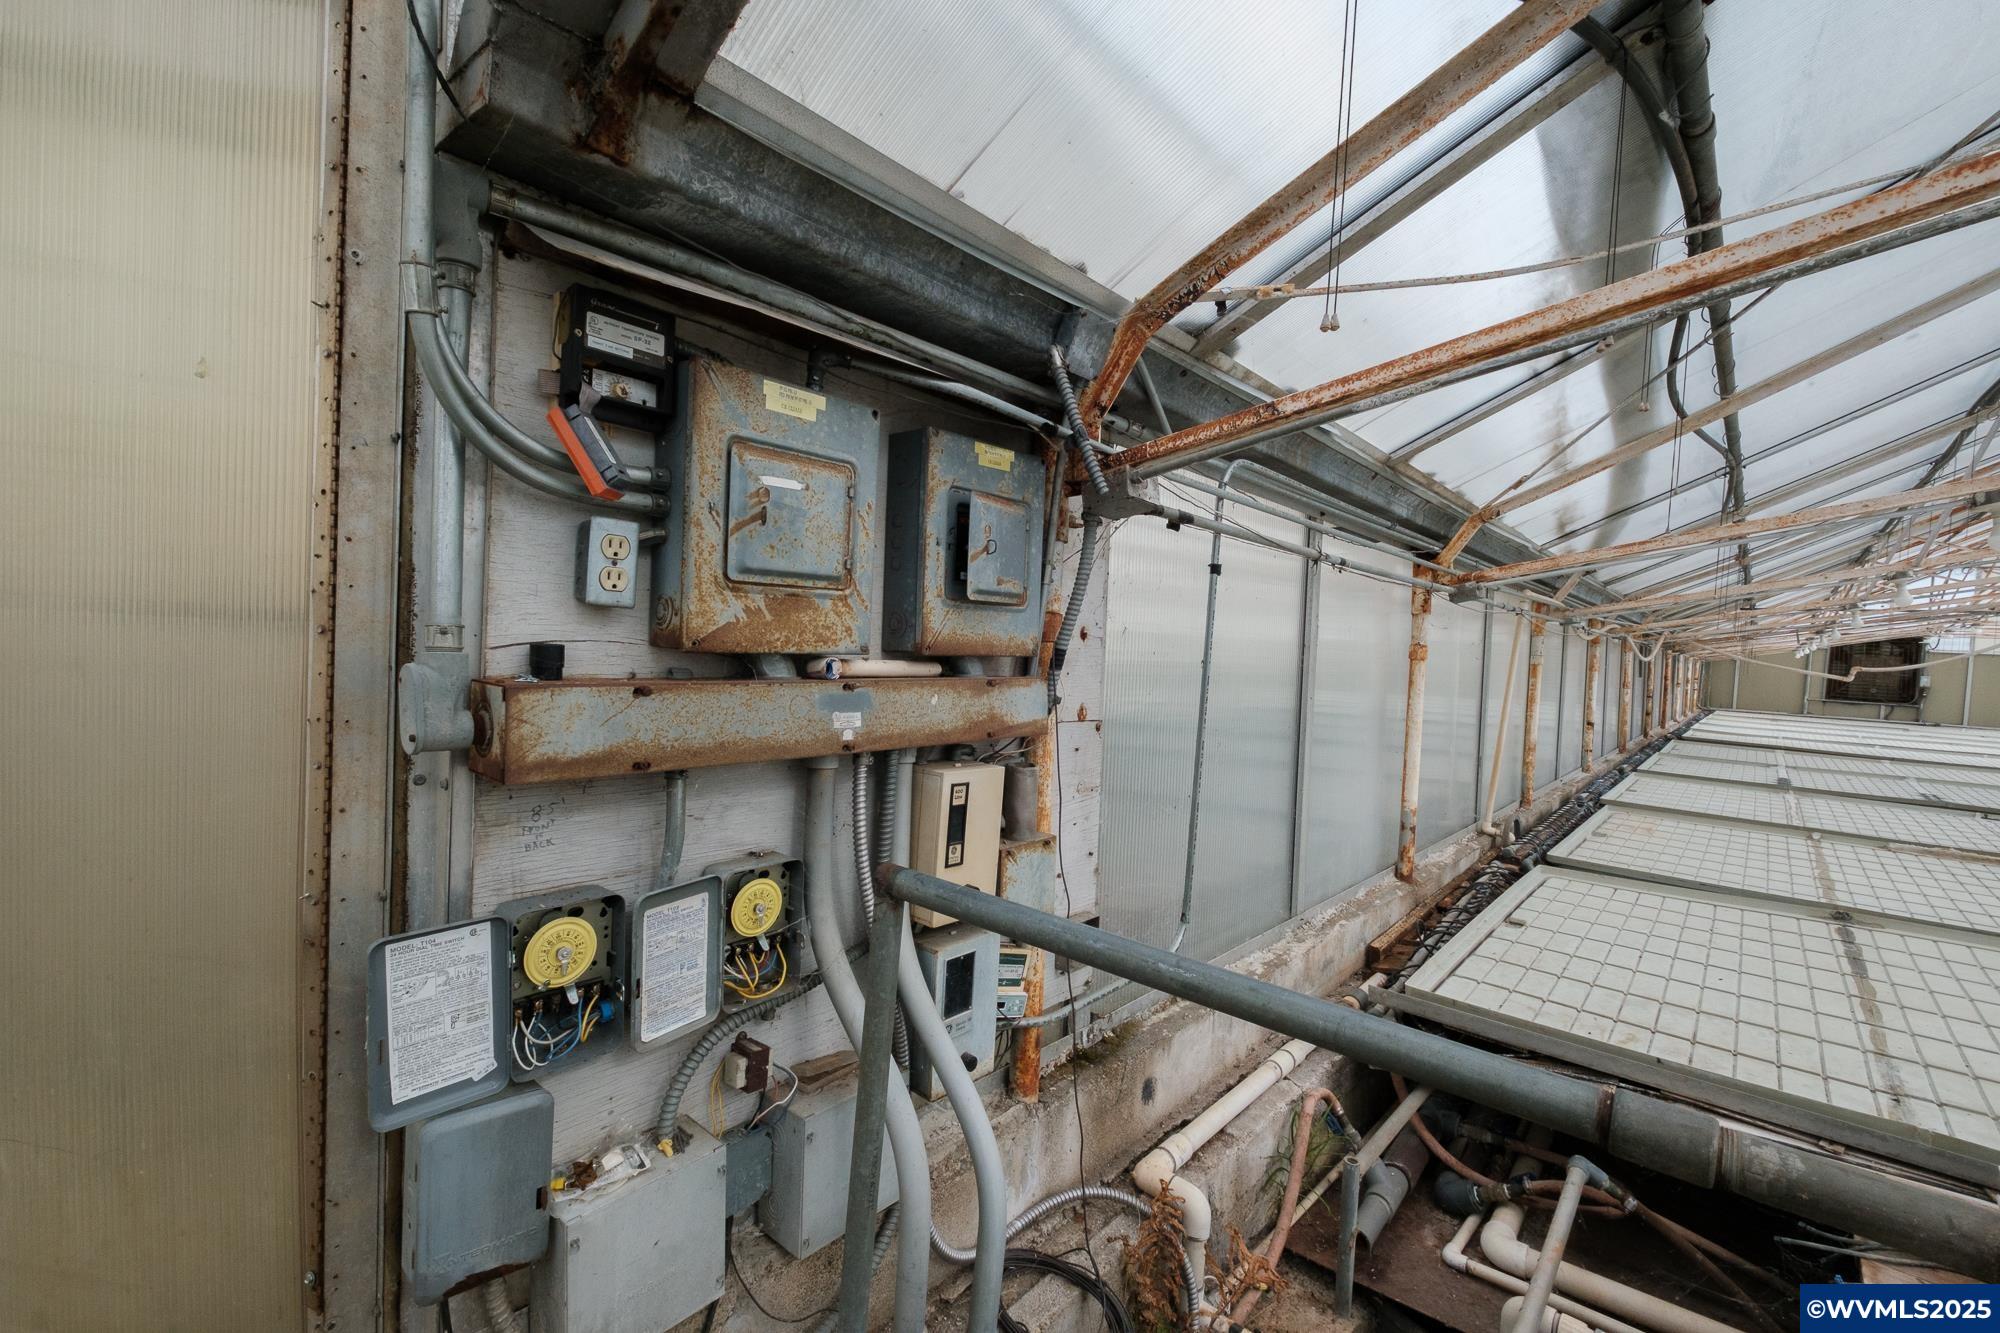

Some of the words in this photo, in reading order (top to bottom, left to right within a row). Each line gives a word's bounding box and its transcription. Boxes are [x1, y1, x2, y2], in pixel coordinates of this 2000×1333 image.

[524, 838, 556, 853] BACK
[398, 948, 415, 957] HOUR
[444, 936, 465, 945] SWITCH
[420, 938, 437, 946] T104
